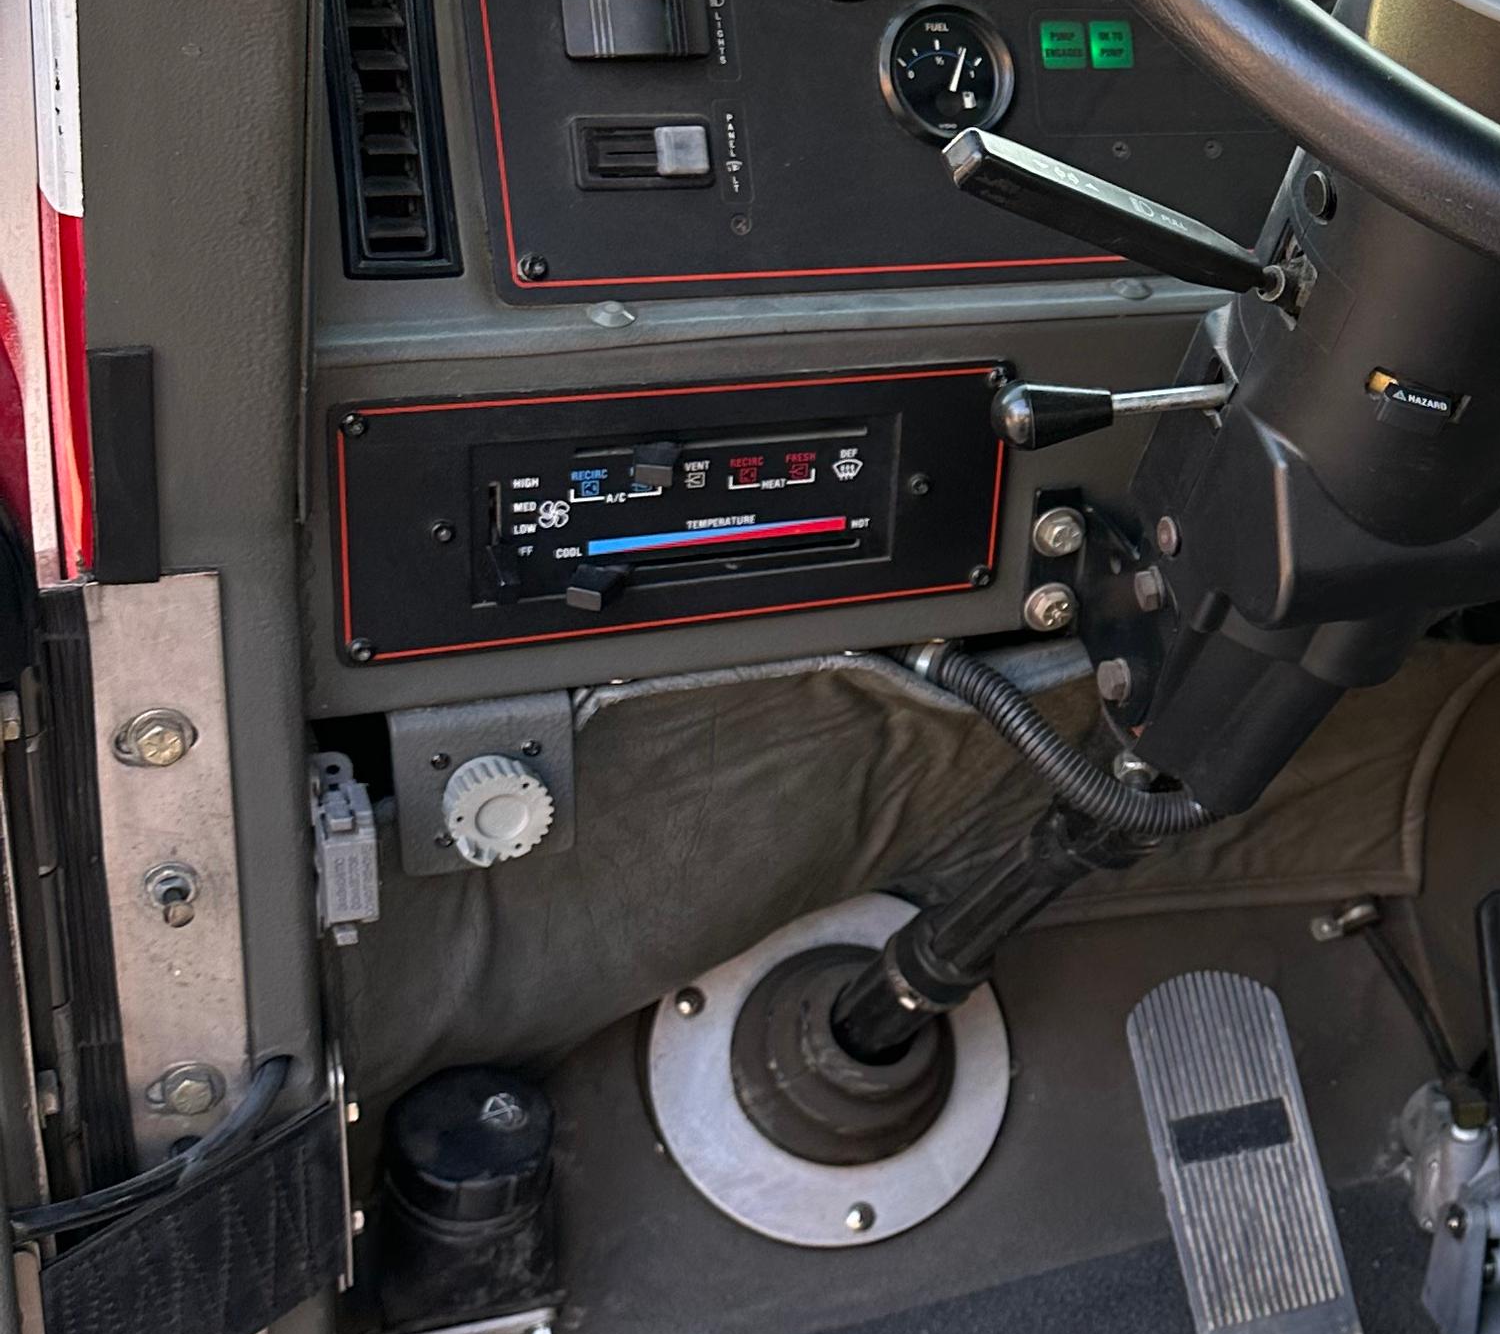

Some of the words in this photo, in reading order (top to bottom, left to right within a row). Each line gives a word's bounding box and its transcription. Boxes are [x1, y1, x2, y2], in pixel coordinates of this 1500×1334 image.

[924, 22, 950, 33] FUEL
[714, 11, 728, 65] LIGHTS
[726, 113, 736, 158] PANEL
[732, 176, 740, 193] LT
[1407, 393, 1448, 411] HAZARD
[785, 452, 816, 463] FRESH
[840, 448, 858, 458] DEF
[684, 460, 710, 471] VENT
[729, 456, 764, 467] RECIRC
[571, 469, 608, 481] RECIRC
[513, 477, 539, 489] HIGH
[761, 478, 786, 489] HEAT
[606, 492, 627, 503] A/C
[513, 501, 537, 513] MED
[686, 514, 756, 530] TEMPERATURE
[850, 518, 870, 528] HOT
[513, 524, 536, 535] LOW
[555, 548, 583, 559] COOL
